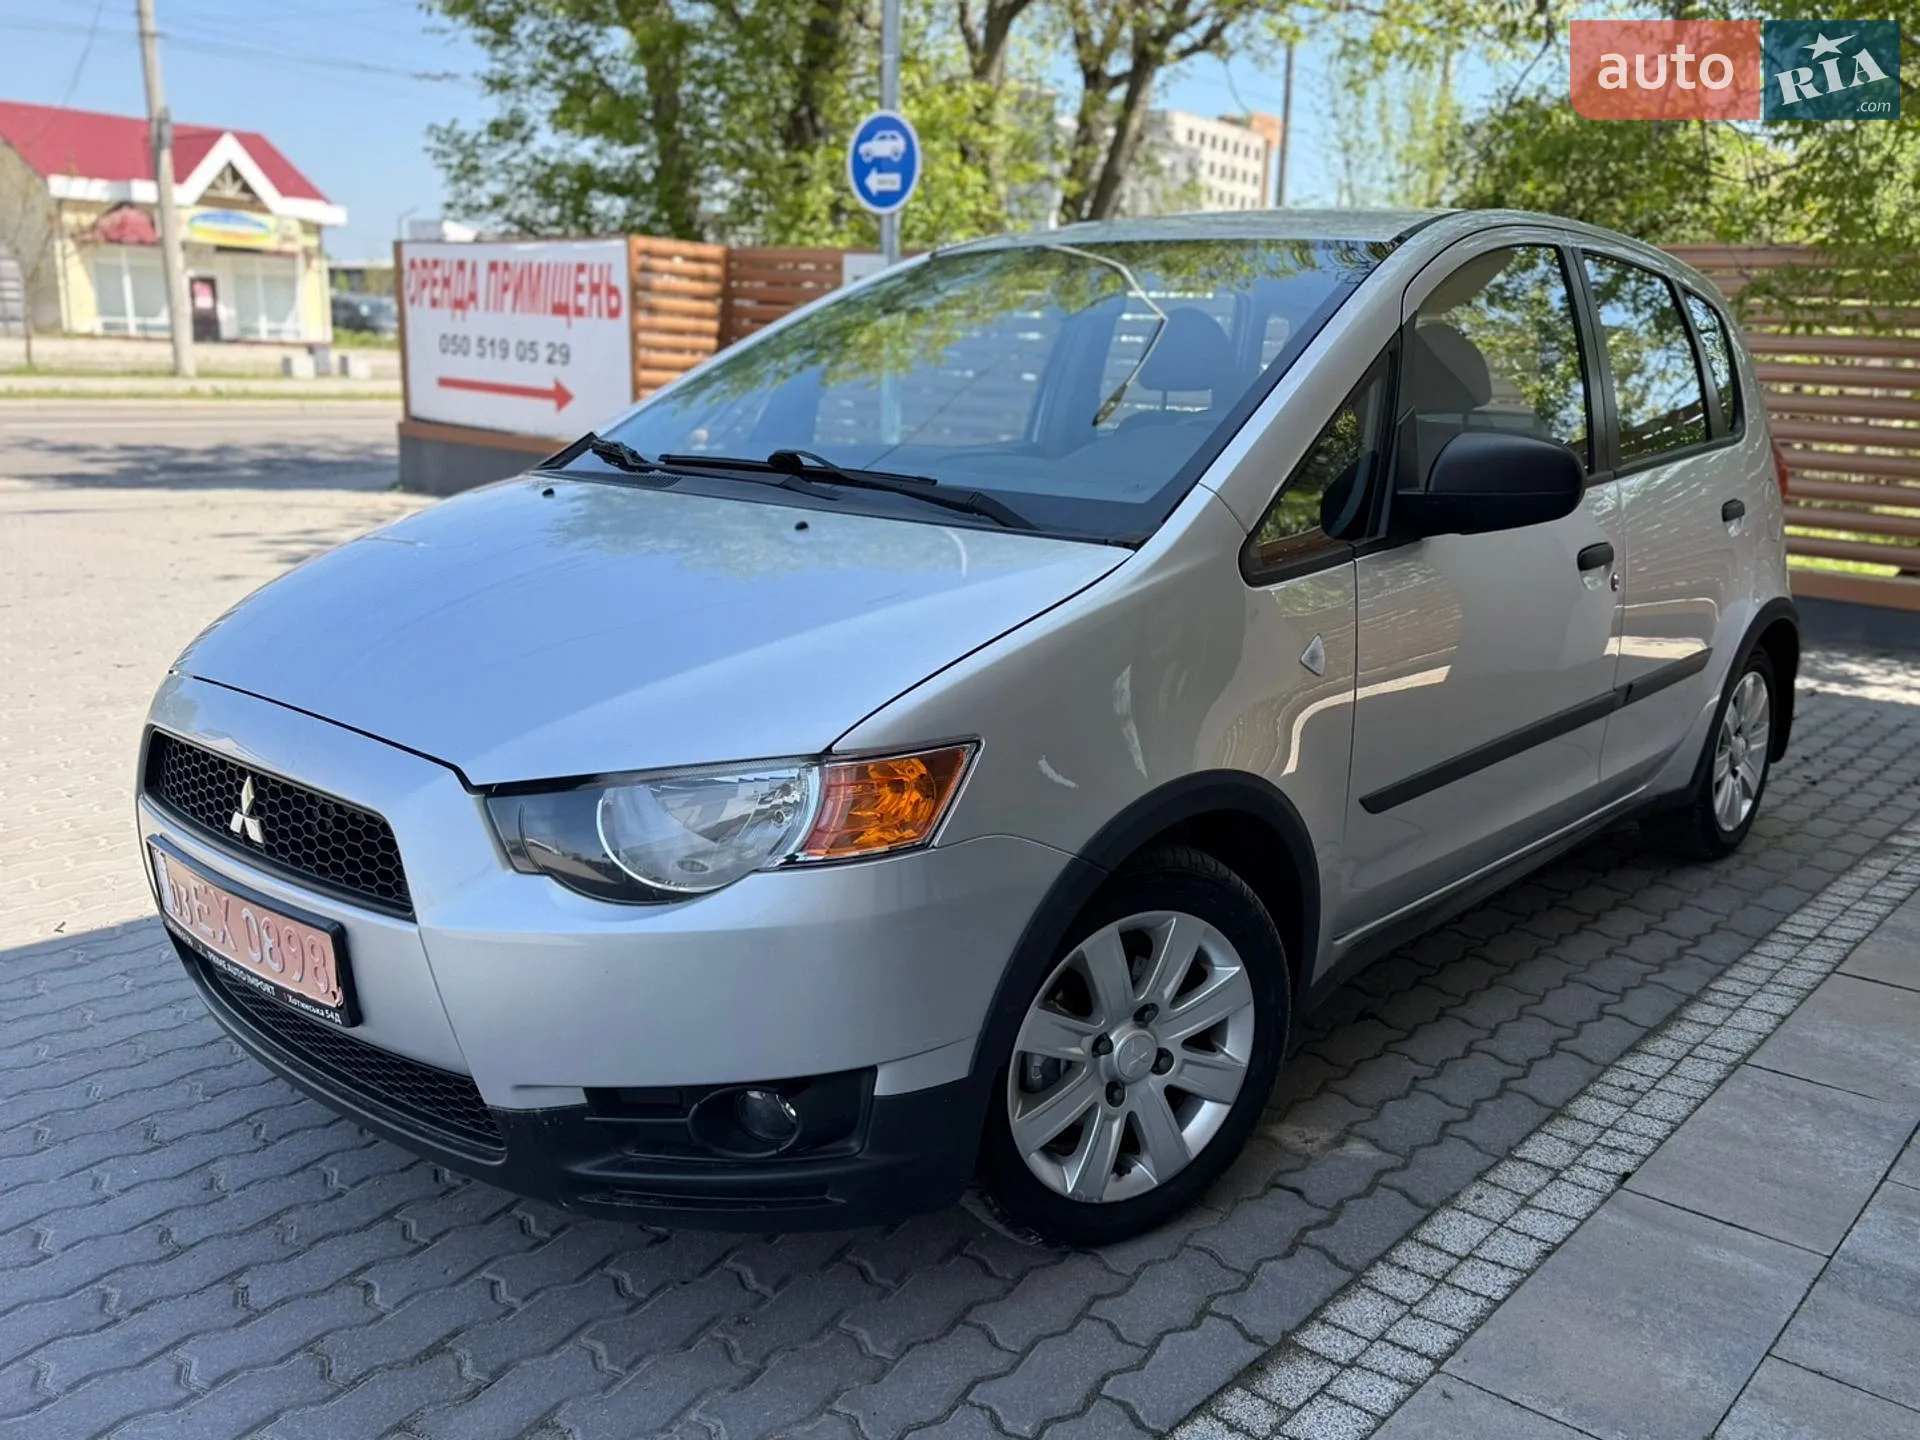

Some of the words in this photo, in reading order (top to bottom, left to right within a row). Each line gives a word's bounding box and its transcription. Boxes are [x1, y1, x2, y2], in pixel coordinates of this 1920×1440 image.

[407, 257, 479, 322] ОРЕНДА
[485, 260, 622, 329] ПРИМІЩЕНЬ
[439, 333, 471, 357] 050
[476, 336, 510, 361] 519
[515, 340, 539, 363] 05
[545, 342, 571, 366] 29
[241, 907, 330, 994] 0898
[225, 962, 246, 981] AUTO
[246, 973, 276, 996] IMPORT
